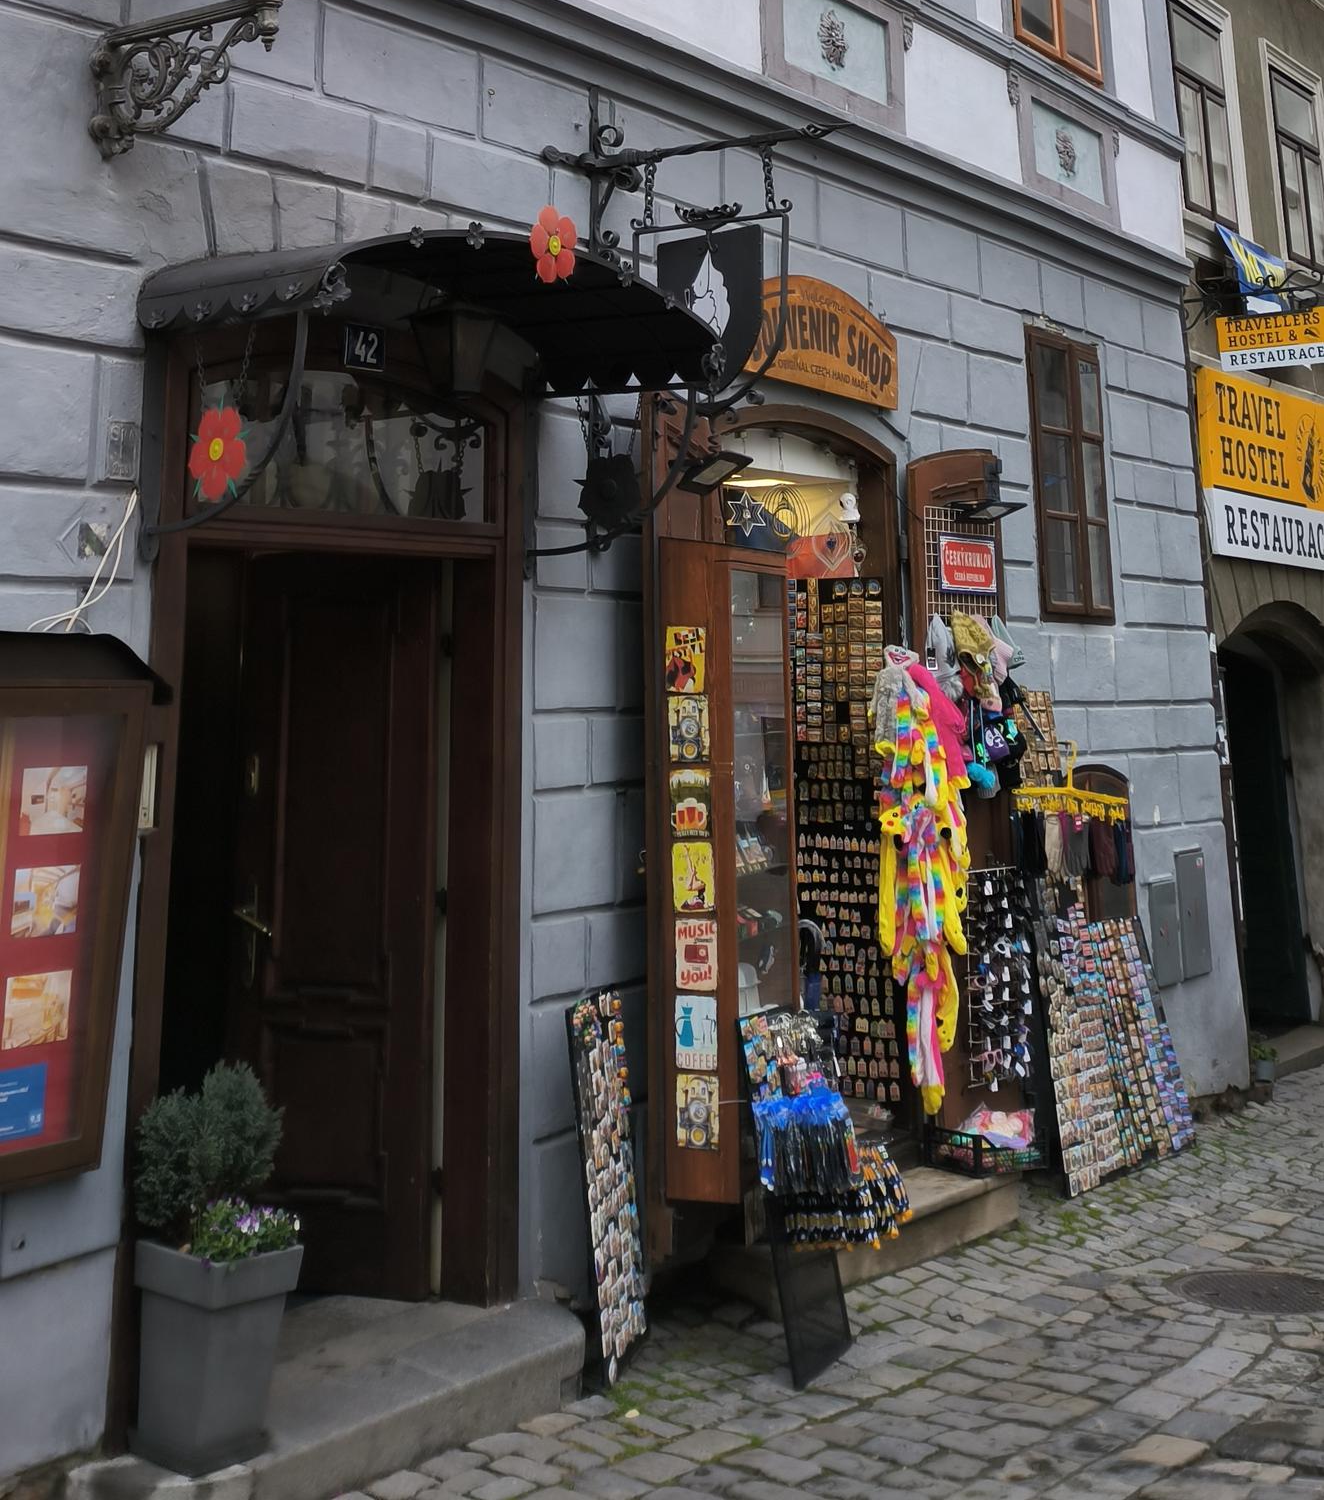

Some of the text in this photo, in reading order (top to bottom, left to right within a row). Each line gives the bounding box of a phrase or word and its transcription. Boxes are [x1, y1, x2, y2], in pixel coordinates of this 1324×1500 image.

[1225, 312, 1320, 333] TRAVELLERS
[355, 331, 378, 364] 42
[1228, 329, 1298, 347] HOSTEL &
[847, 324, 892, 392] SHOP
[1230, 346, 1324, 366] RESTAURACE
[1215, 381, 1286, 440] TRAVEL
[1220, 435, 1290, 489] HOSTEL
[678, 921, 715, 940] MUSIC
[677, 1053, 717, 1070] COFFEE
